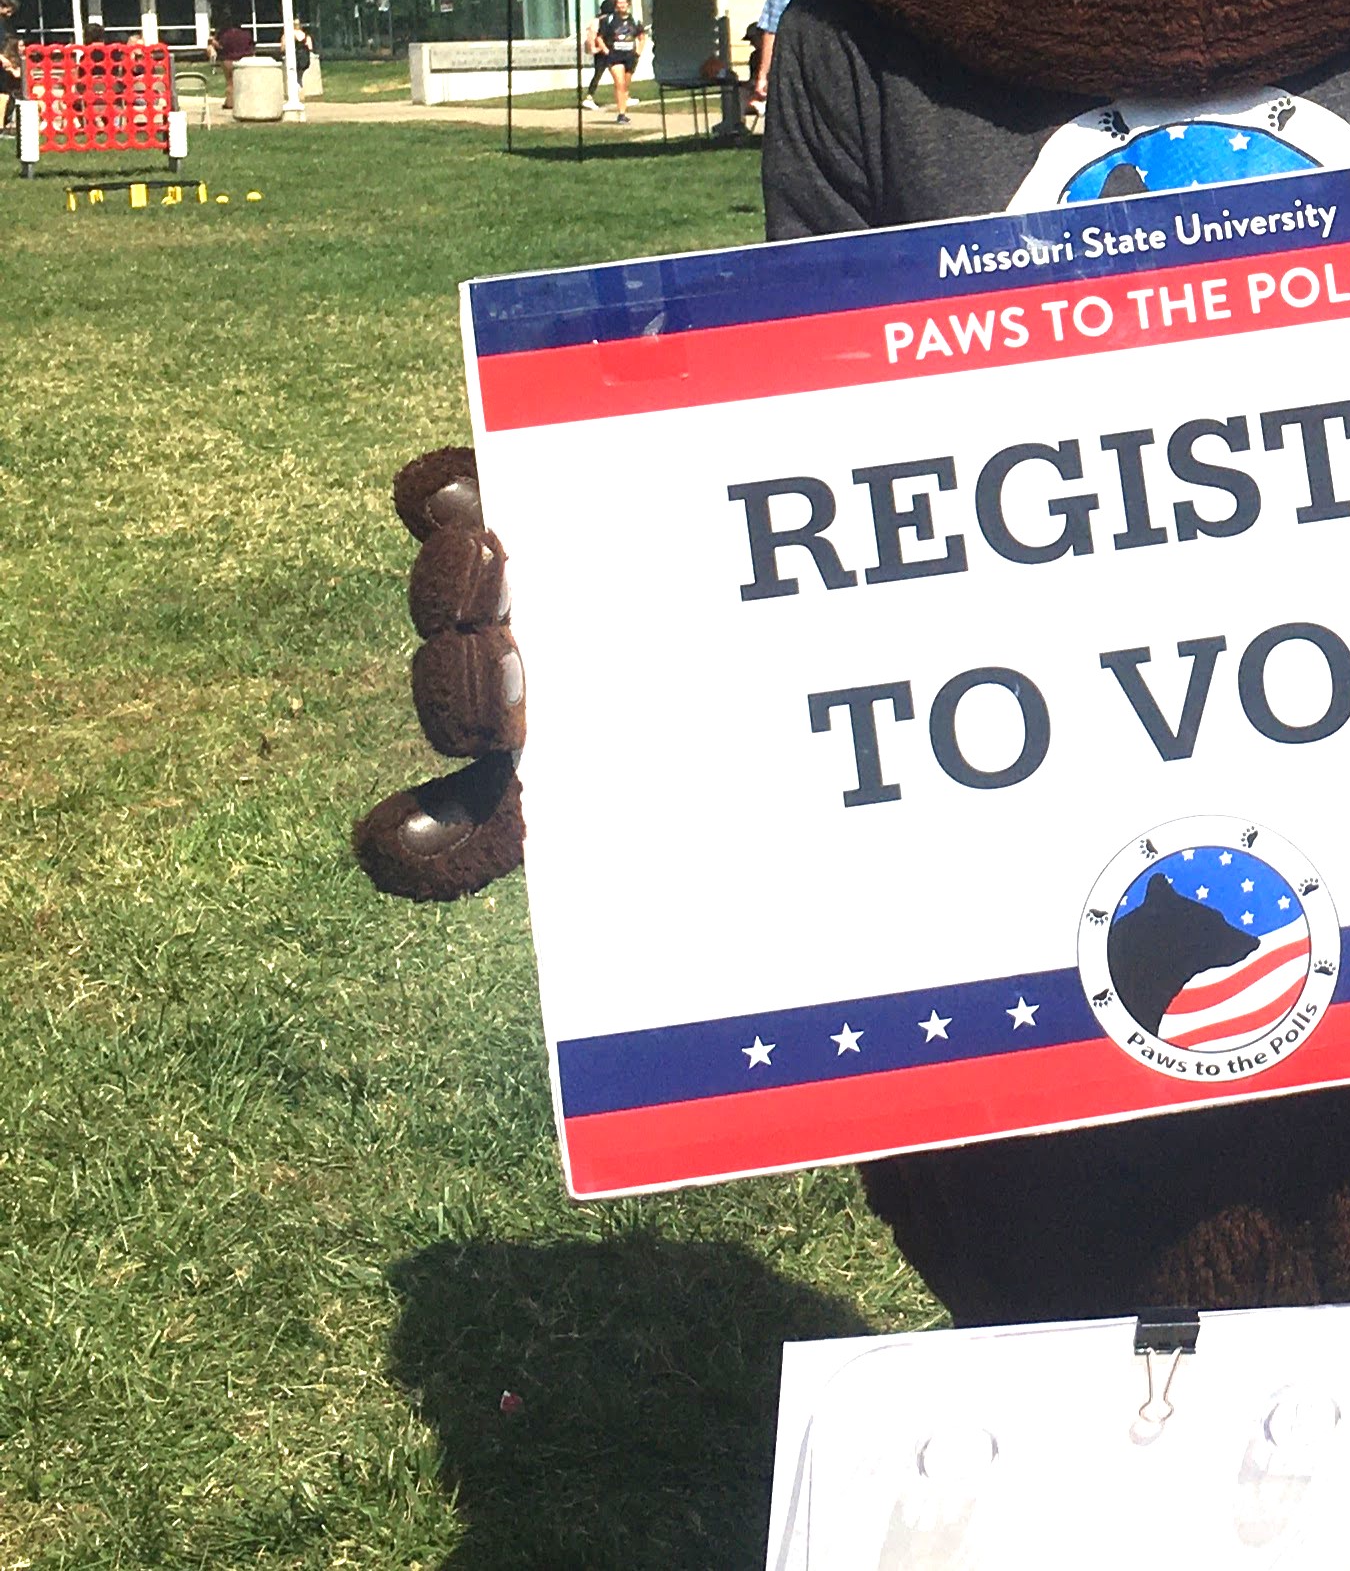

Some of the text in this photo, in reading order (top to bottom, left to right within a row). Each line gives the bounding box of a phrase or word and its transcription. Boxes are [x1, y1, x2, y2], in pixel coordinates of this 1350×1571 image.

[938, 199, 1337, 278] Missouri State University
[884, 306, 1030, 364] PAWS
[1041, 295, 1114, 342] TO
[1126, 278, 1232, 330] THE
[808, 668, 1050, 807] TO
[1126, 1001, 1319, 1077] Paws to the Polls
